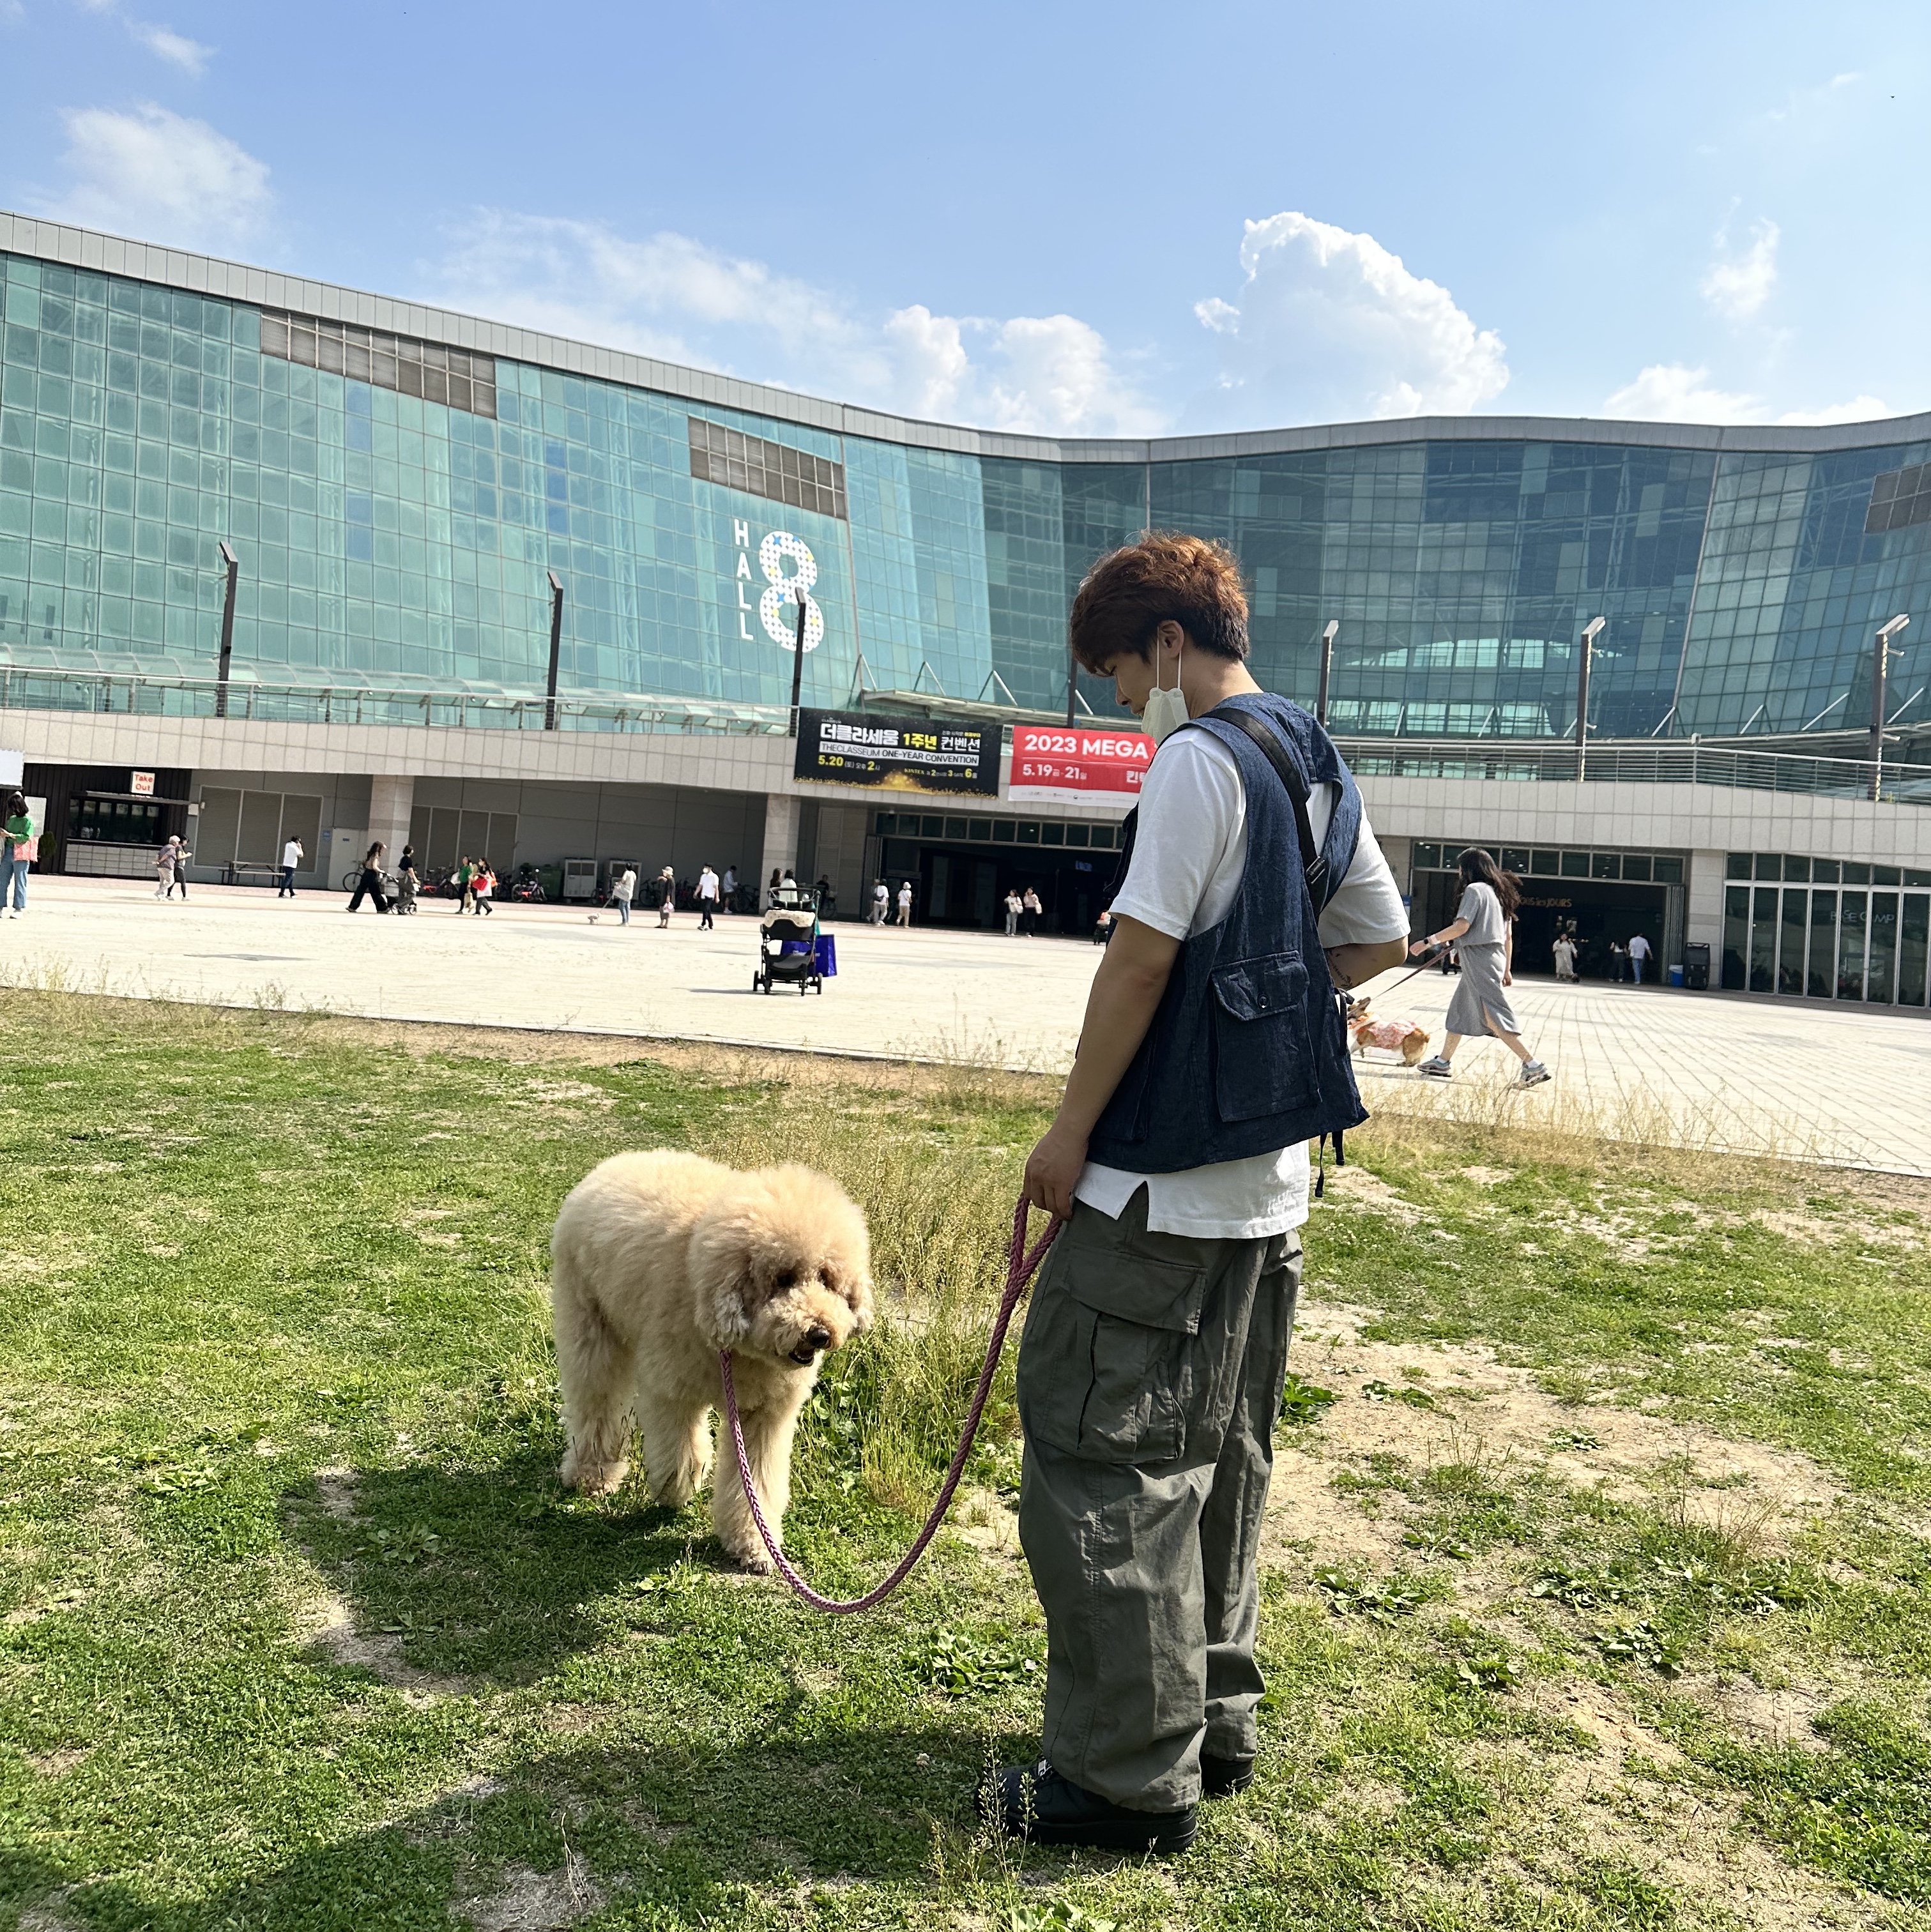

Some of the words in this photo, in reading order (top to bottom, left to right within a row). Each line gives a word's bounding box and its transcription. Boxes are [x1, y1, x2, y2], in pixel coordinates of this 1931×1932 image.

[735, 519, 753, 640] HALL
[759, 531, 824, 653] 8
[820, 723, 899, 745] 더클라세움
[903, 733, 937, 750] 1주년
[941, 736, 981, 752] 컨벤션
[1025, 734, 1077, 754] 2023
[1082, 738, 1149, 759] MEGA
[818, 755, 843, 766] 5.20
[821, 743, 880, 757] THECLASSEUM
[882, 749, 923, 760] ONE-YEAR
[925, 754, 978, 764] CONVENTION
[135, 774, 153, 782] Take
[1830, 909, 1858, 923] BSE
[1859, 911, 1895, 924] CMP
